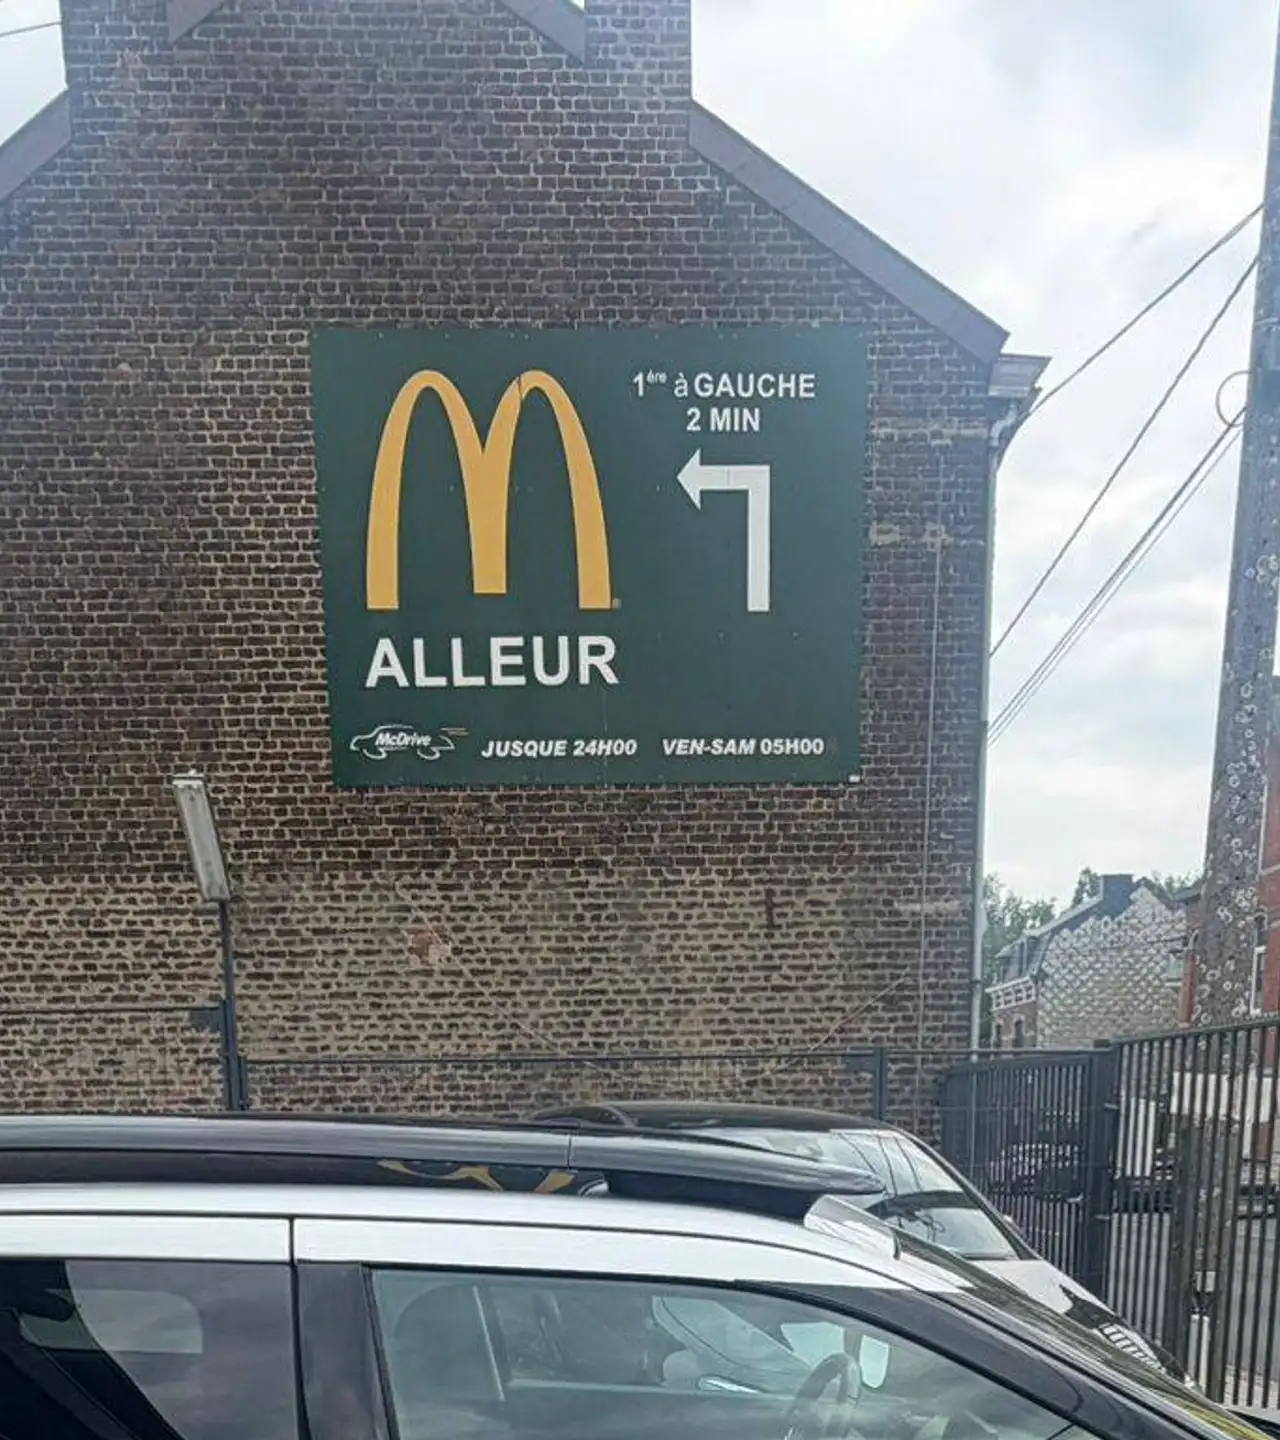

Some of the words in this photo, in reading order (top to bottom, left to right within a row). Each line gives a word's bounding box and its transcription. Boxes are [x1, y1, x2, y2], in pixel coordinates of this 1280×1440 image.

[694, 372, 816, 398] GAUCHE
[686, 406, 701, 432] 2
[710, 407, 760, 432] MIN
[365, 635, 619, 688] ALLEUR
[375, 732, 432, 747] McDrive
[480, 740, 568, 758] JUSQUE
[572, 739, 638, 757] 24H00
[662, 738, 756, 755] VEN-SAM
[760, 738, 824, 755] 05H00
